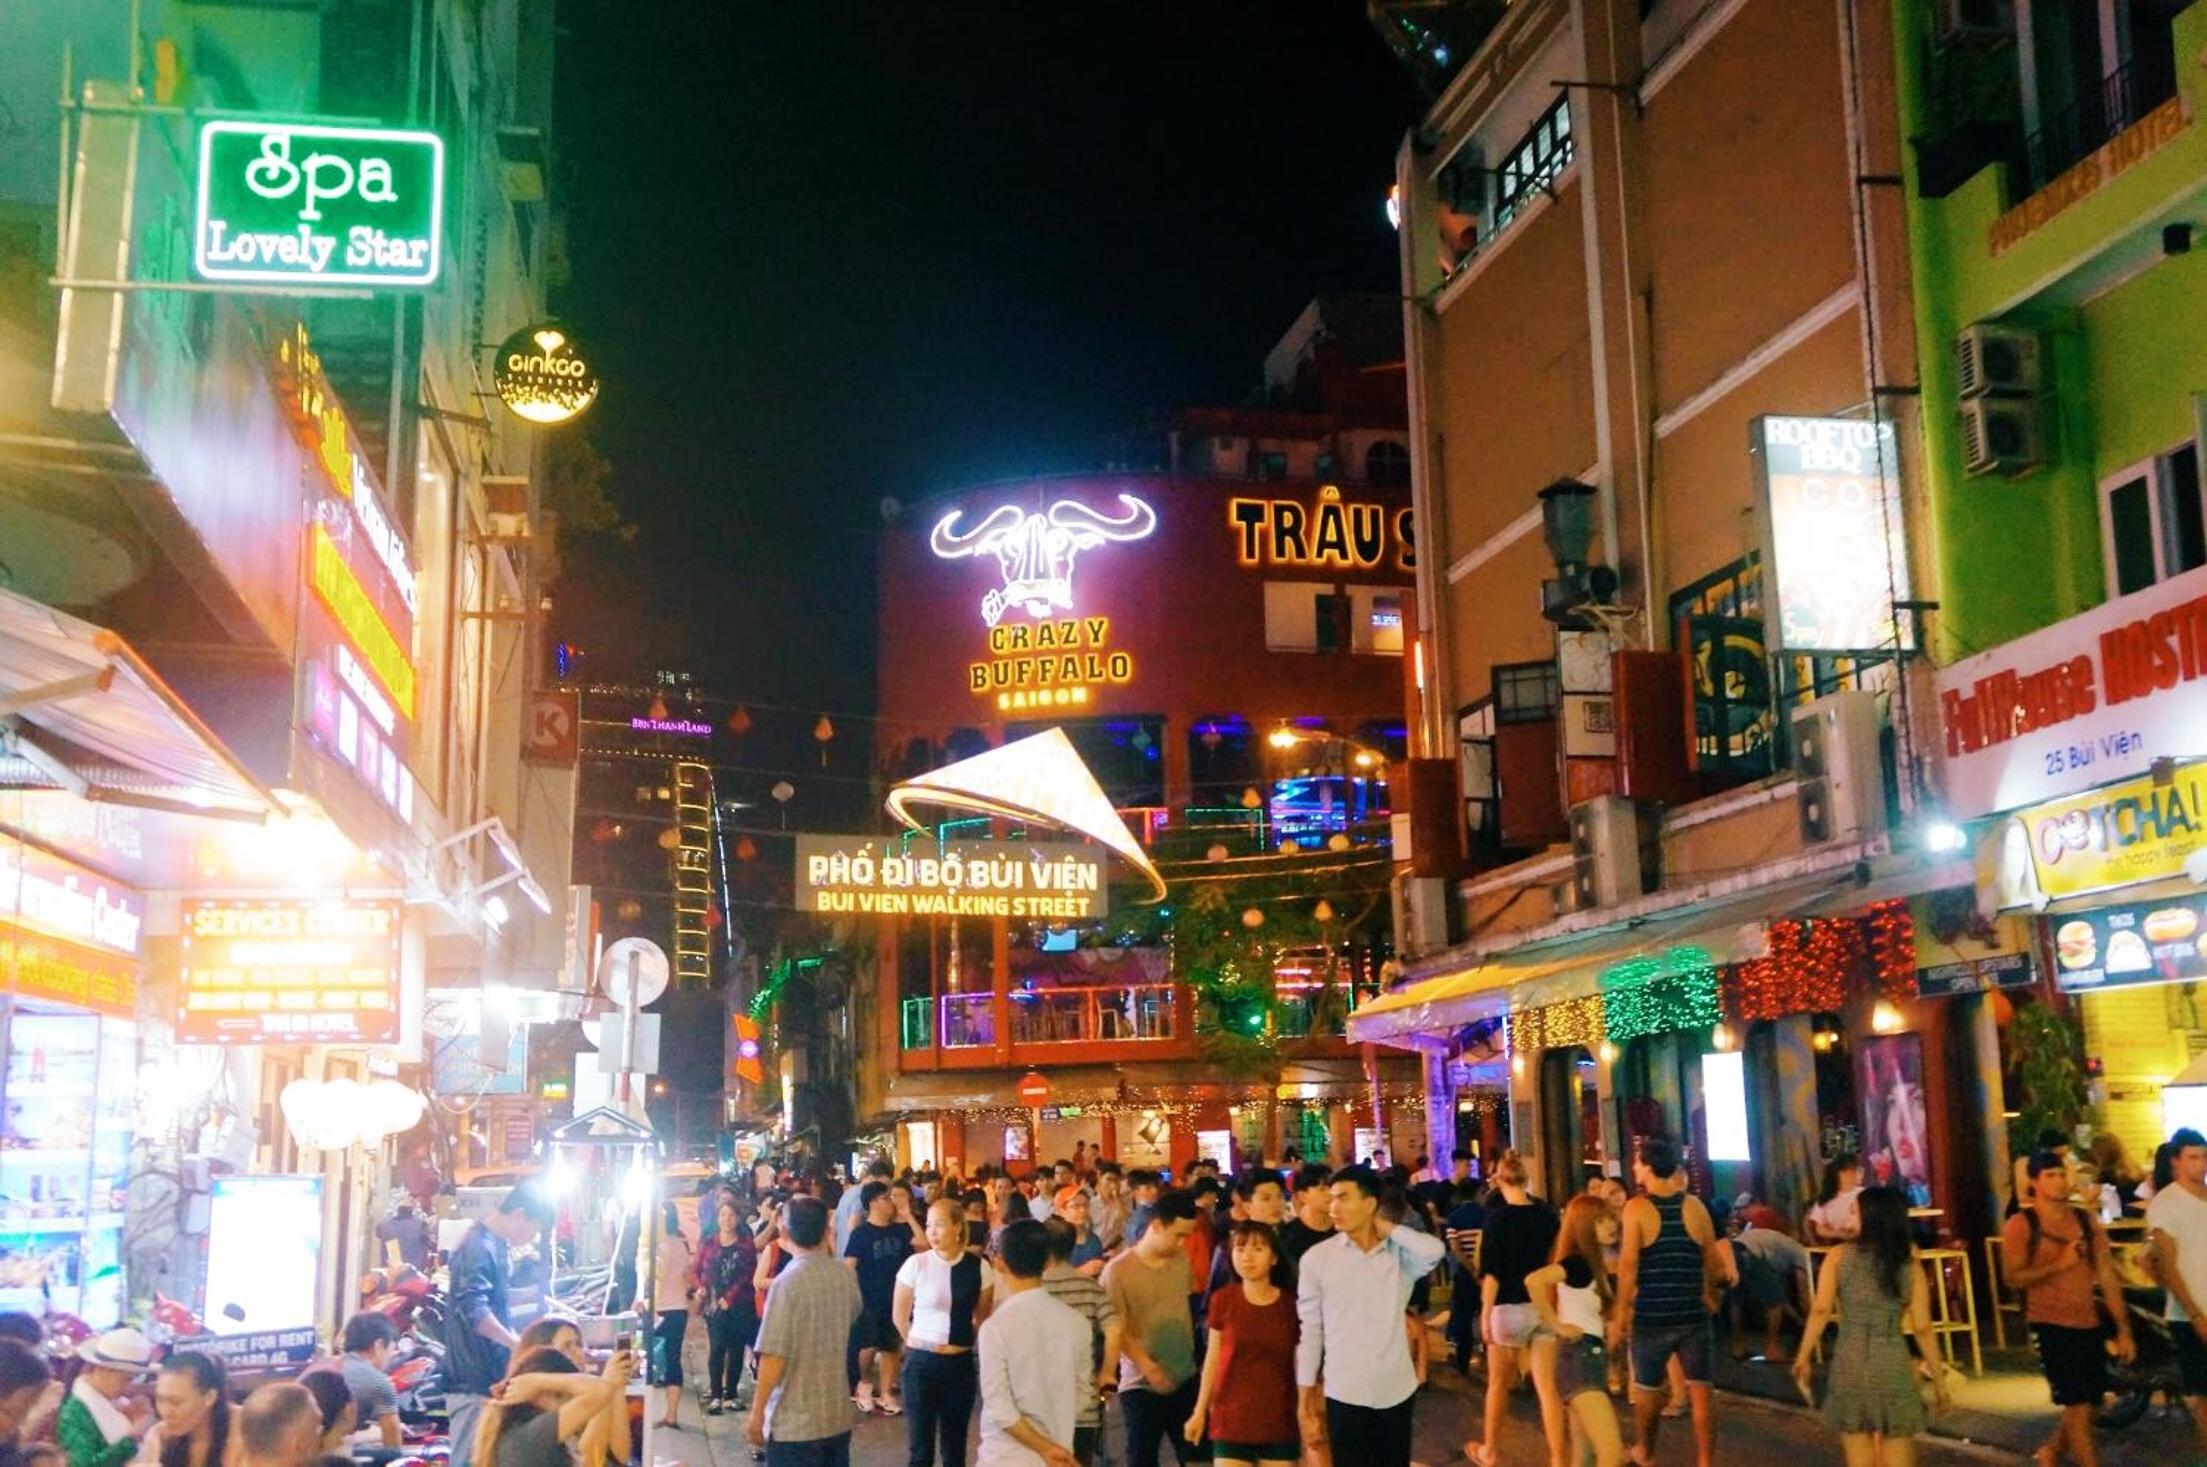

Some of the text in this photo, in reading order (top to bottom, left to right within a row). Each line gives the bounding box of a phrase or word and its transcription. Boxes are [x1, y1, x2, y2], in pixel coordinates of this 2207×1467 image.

[245, 133, 398, 220] Spa
[207, 221, 429, 272] Lovely Star
[1233, 486, 1384, 566] TRÂU
[991, 618, 1108, 652] CRAZY
[2099, 592, 2207, 706] HOST
[971, 653, 1130, 691] BUFFALO
[2046, 750, 2065, 776] 25
[969, 852, 1024, 889] BÙI
[1030, 855, 1097, 897] VIỆN
[818, 891, 1090, 917] BUI VIEN WALKING STREET
[249, 1335, 277, 1351] FOR
[278, 1330, 314, 1347] RENT
